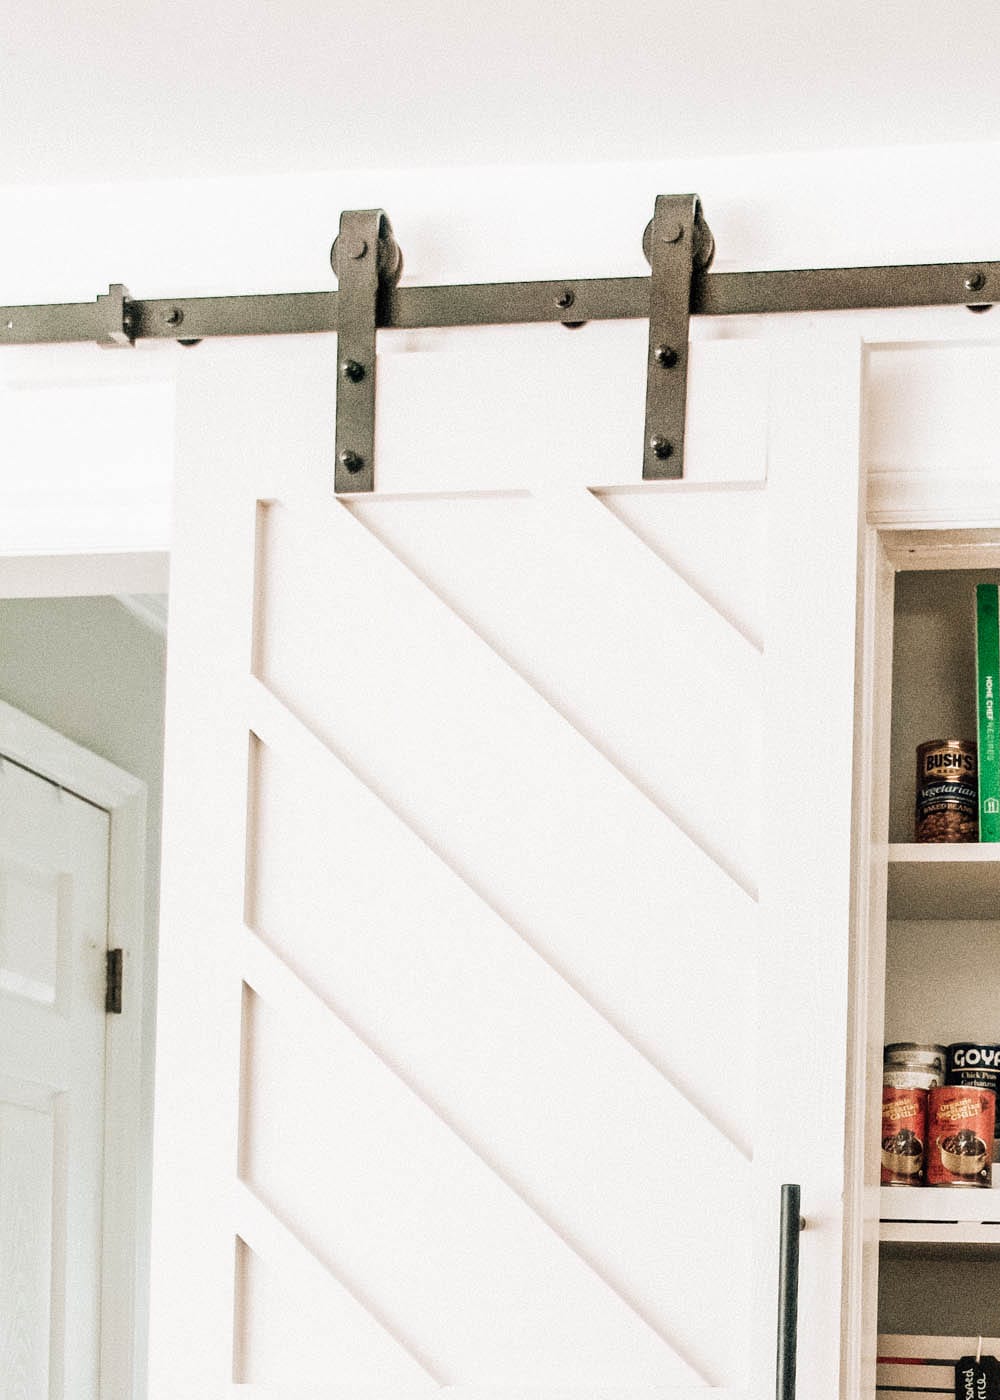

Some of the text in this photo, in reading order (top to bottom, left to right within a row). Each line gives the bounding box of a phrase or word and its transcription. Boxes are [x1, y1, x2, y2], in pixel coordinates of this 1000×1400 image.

[985, 676, 993, 698] HOME
[986, 700, 994, 720] CHEF
[926, 754, 973, 771] BUSH'S
[975, 1372, 987, 1399] rice
